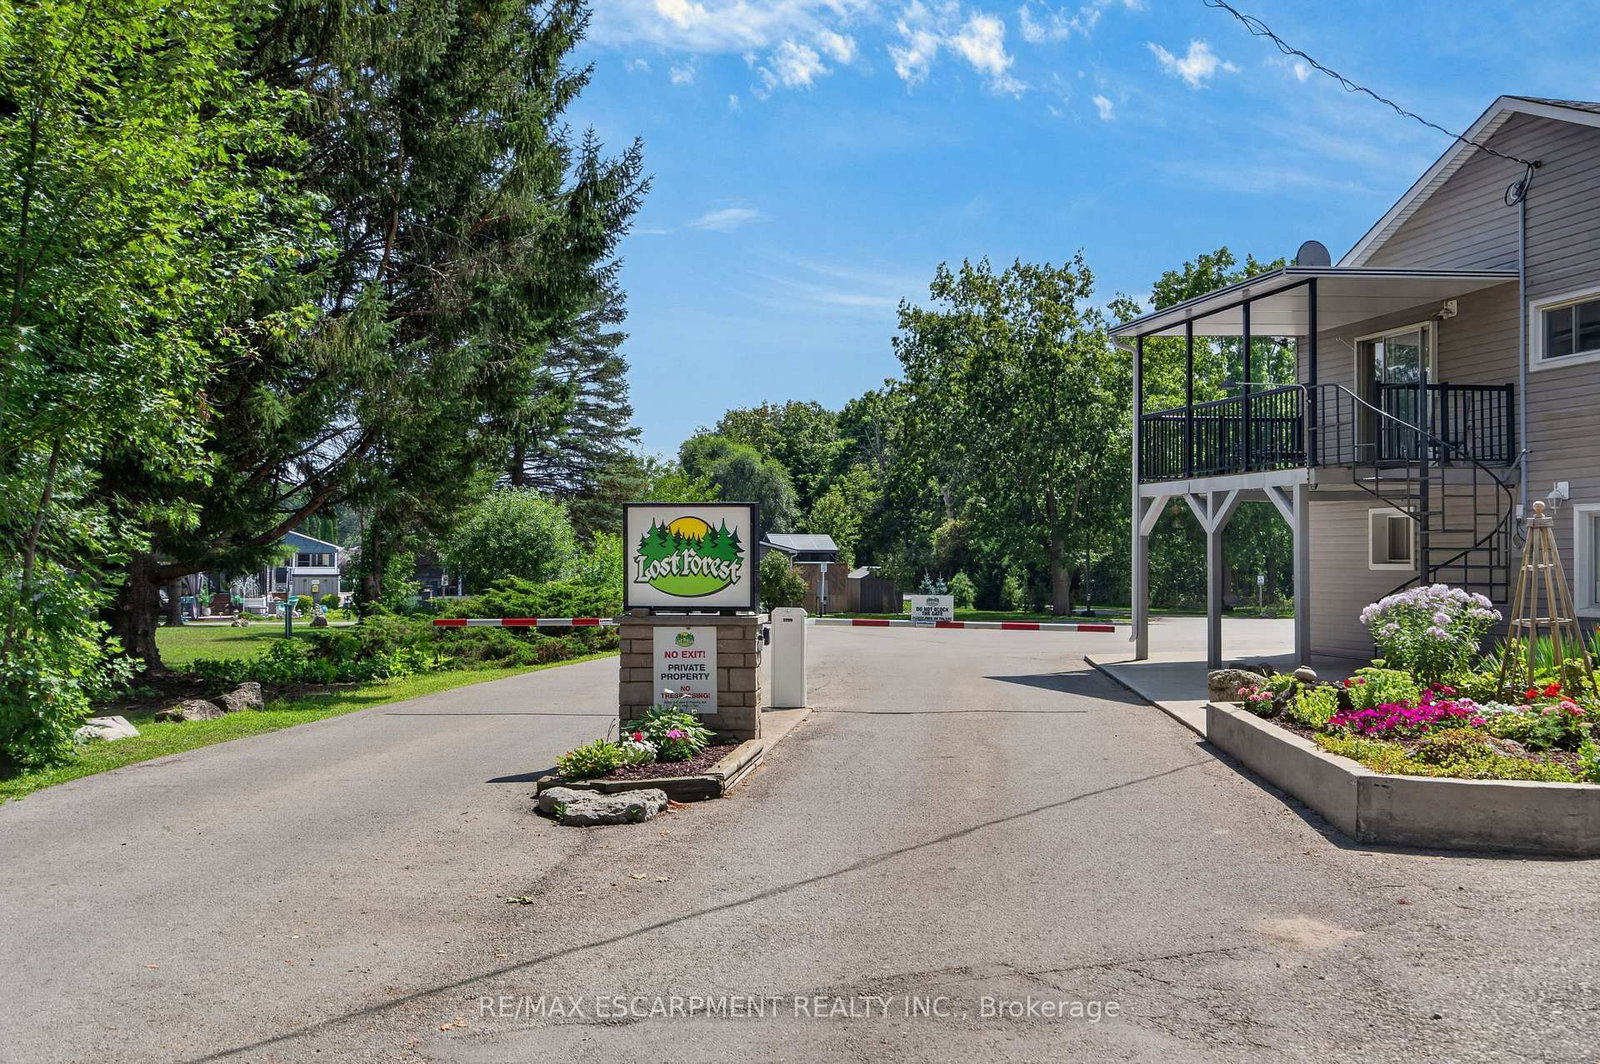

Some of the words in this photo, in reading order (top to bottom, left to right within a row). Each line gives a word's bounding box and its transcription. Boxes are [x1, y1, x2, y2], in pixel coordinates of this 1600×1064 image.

[633, 549, 681, 584] Lost
[680, 547, 743, 585] Forest
[664, 650, 679, 659] NO
[681, 650, 706, 659] EXIT!
[660, 672, 710, 681] PROPERTY
